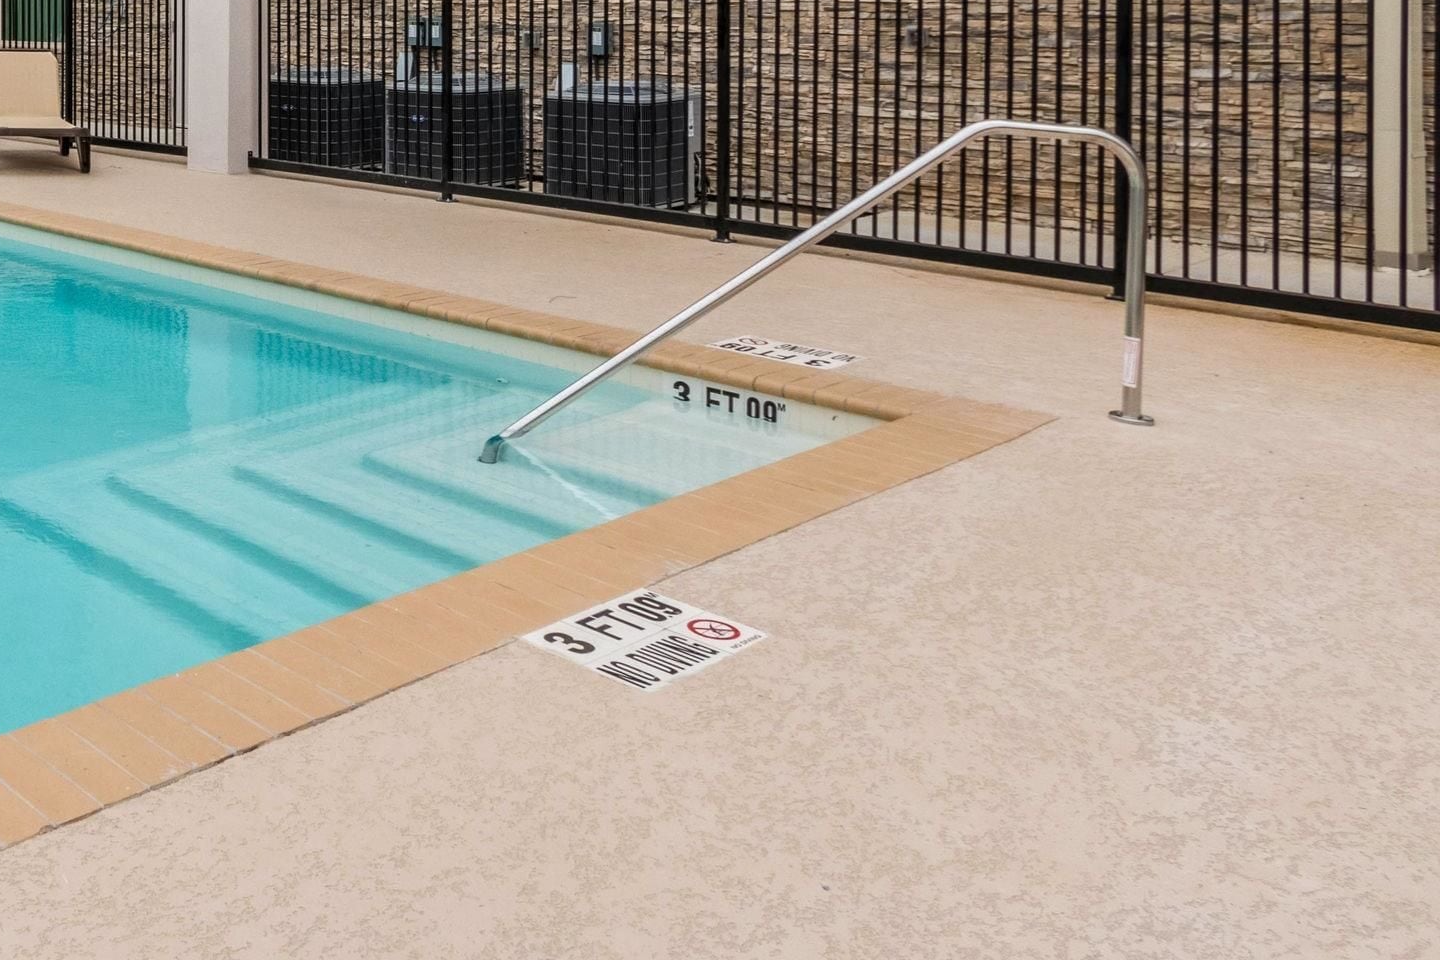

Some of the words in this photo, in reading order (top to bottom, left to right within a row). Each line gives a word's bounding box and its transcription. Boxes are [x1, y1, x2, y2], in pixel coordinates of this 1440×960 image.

[673, 381, 690, 401] 3
[706, 387, 740, 413] FT
[543, 632, 595, 654] 3
[575, 609, 645, 640] FT
[625, 635, 720, 675] DIVING
[596, 661, 660, 688] NO
